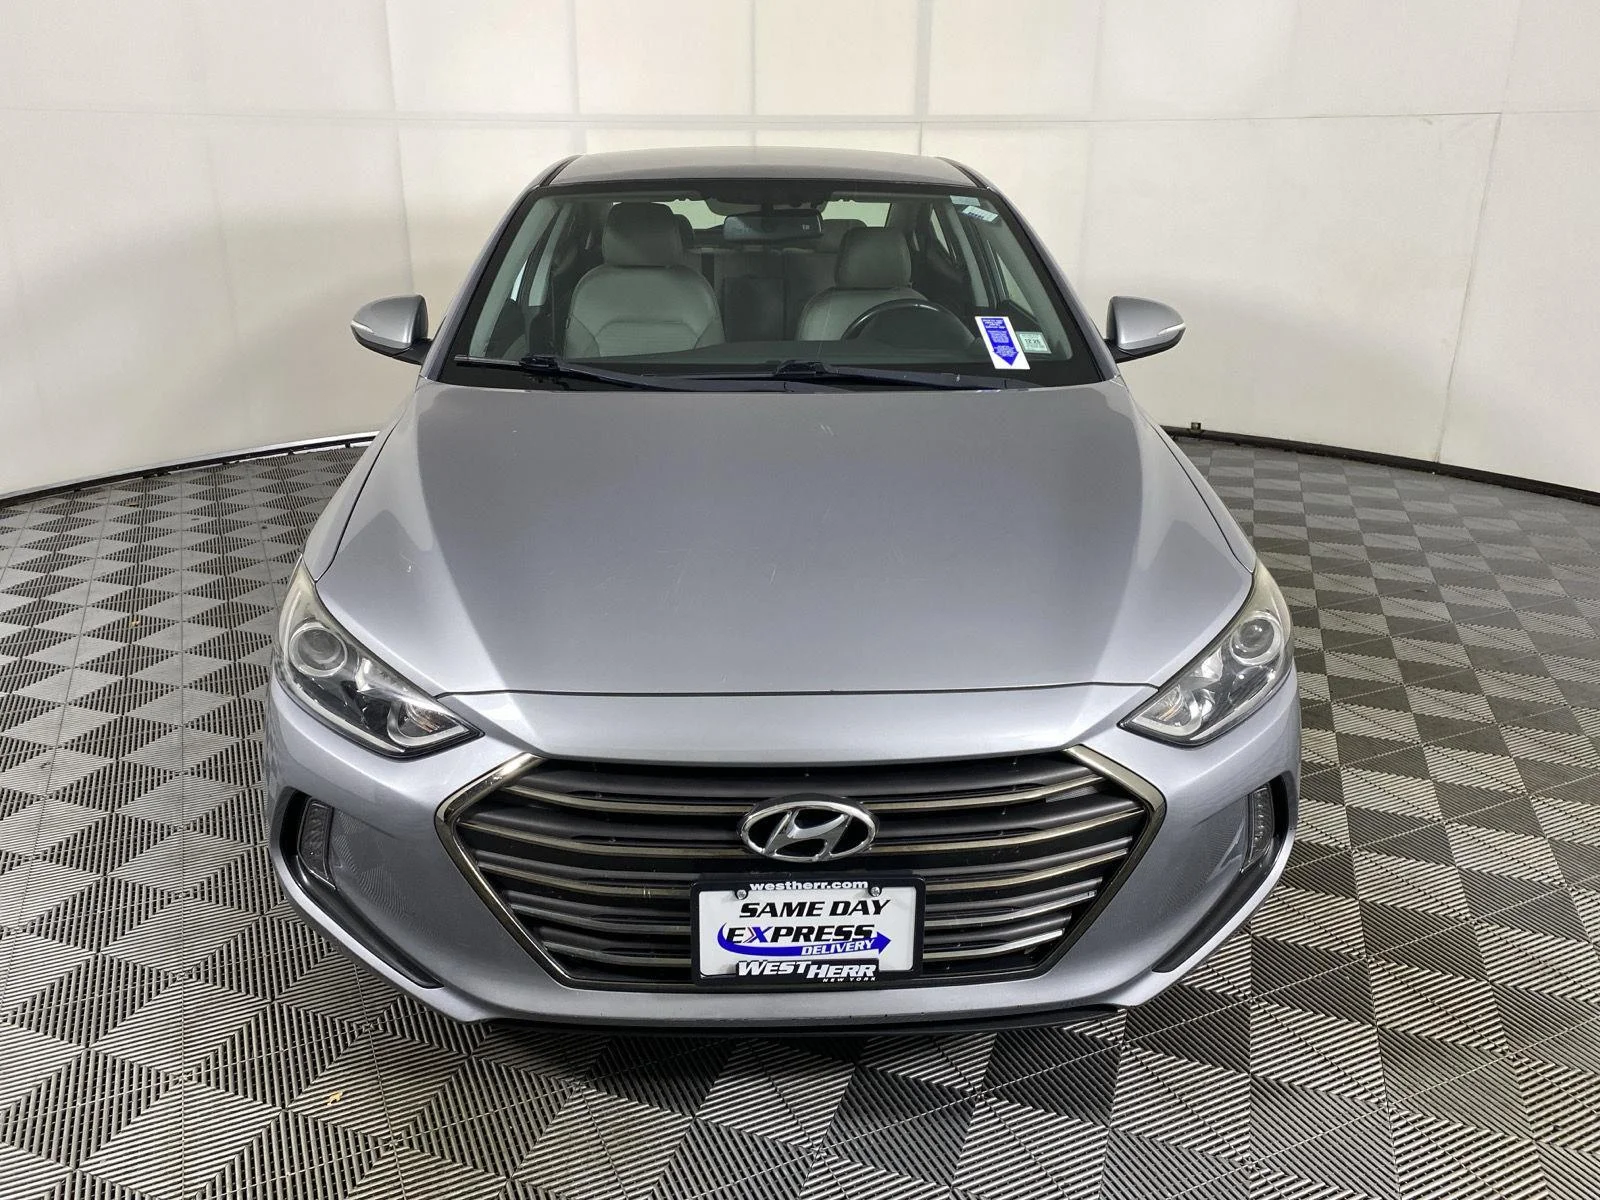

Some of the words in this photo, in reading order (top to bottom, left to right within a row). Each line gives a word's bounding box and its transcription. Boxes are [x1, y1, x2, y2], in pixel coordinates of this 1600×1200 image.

[749, 881, 868, 891] westherr.com
[739, 901, 824, 918] SAME
[829, 899, 891, 916] DAY
[726, 925, 875, 943] EXPRESS
[800, 939, 875, 956] DELIVERY
